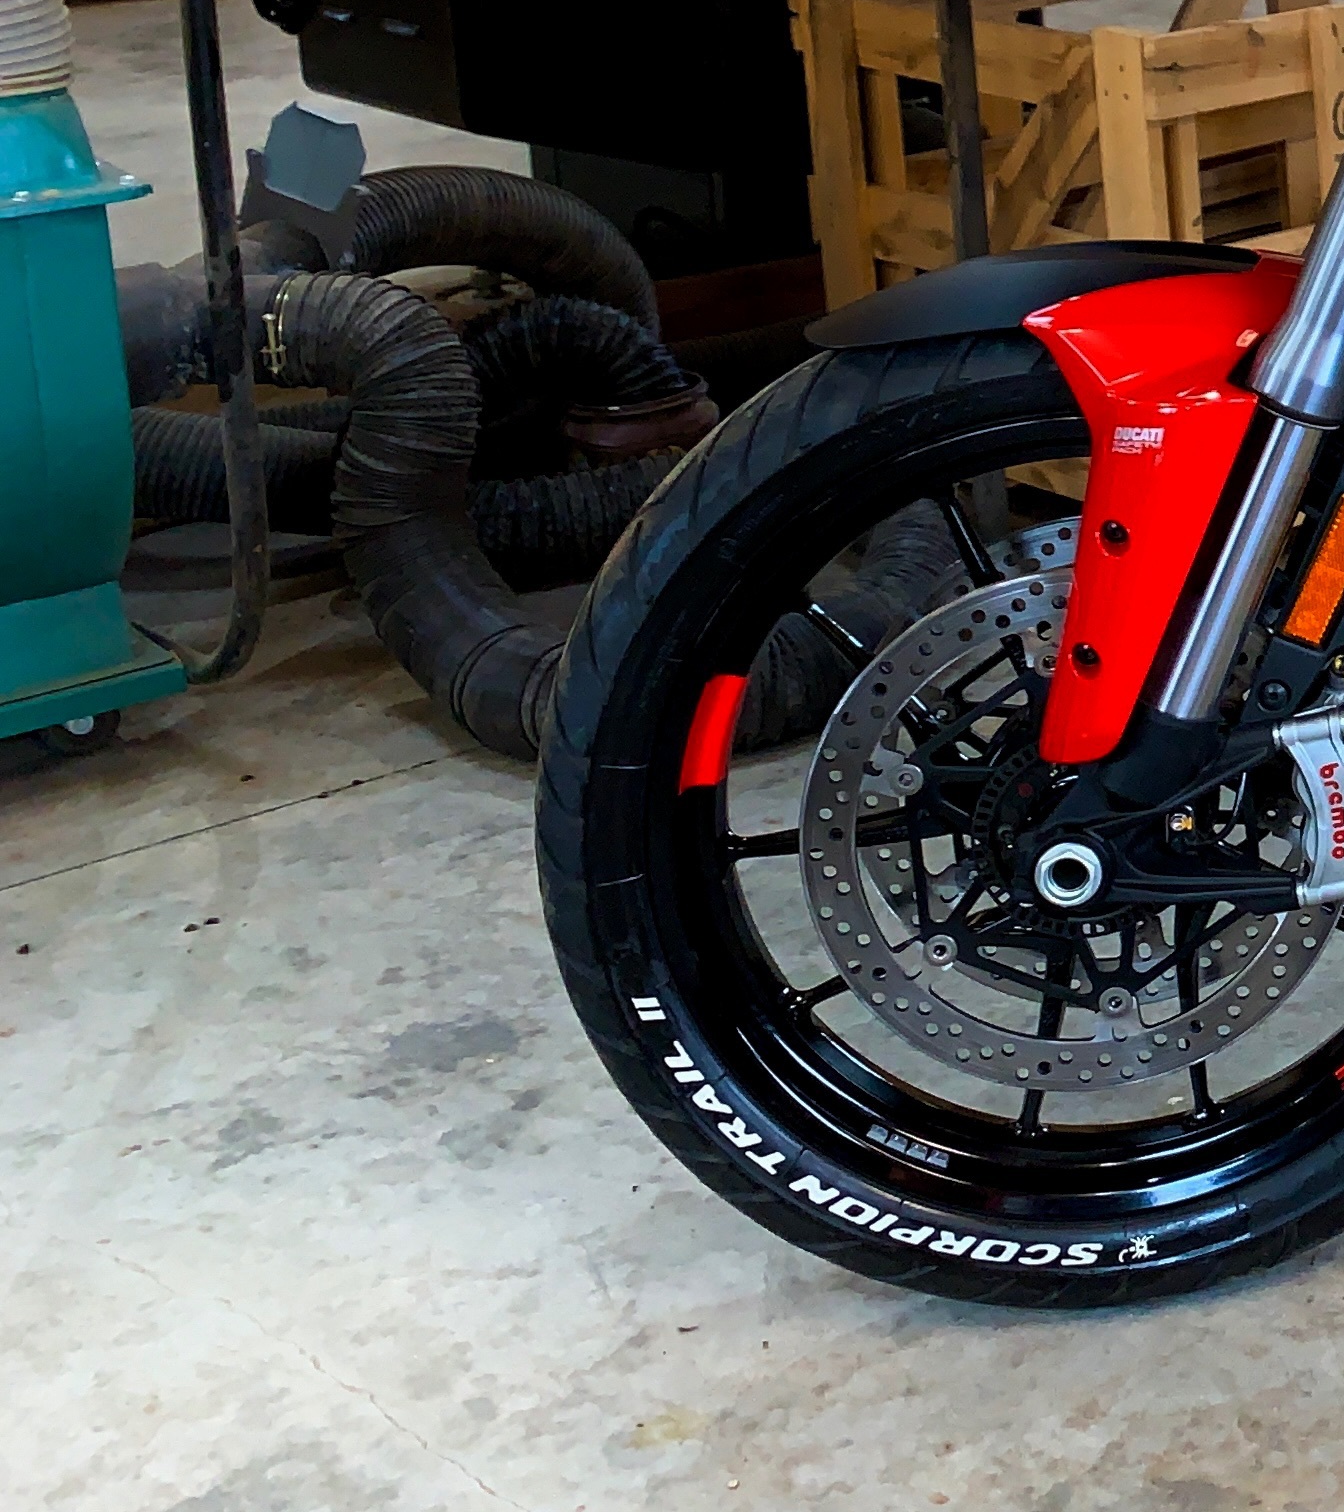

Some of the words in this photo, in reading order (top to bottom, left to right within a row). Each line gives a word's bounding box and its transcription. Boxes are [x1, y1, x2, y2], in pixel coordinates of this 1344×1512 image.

[1113, 426, 1166, 441] DUCATI
[664, 1040, 787, 1176] TRAIL
[788, 1174, 1104, 1268] SCORPION
